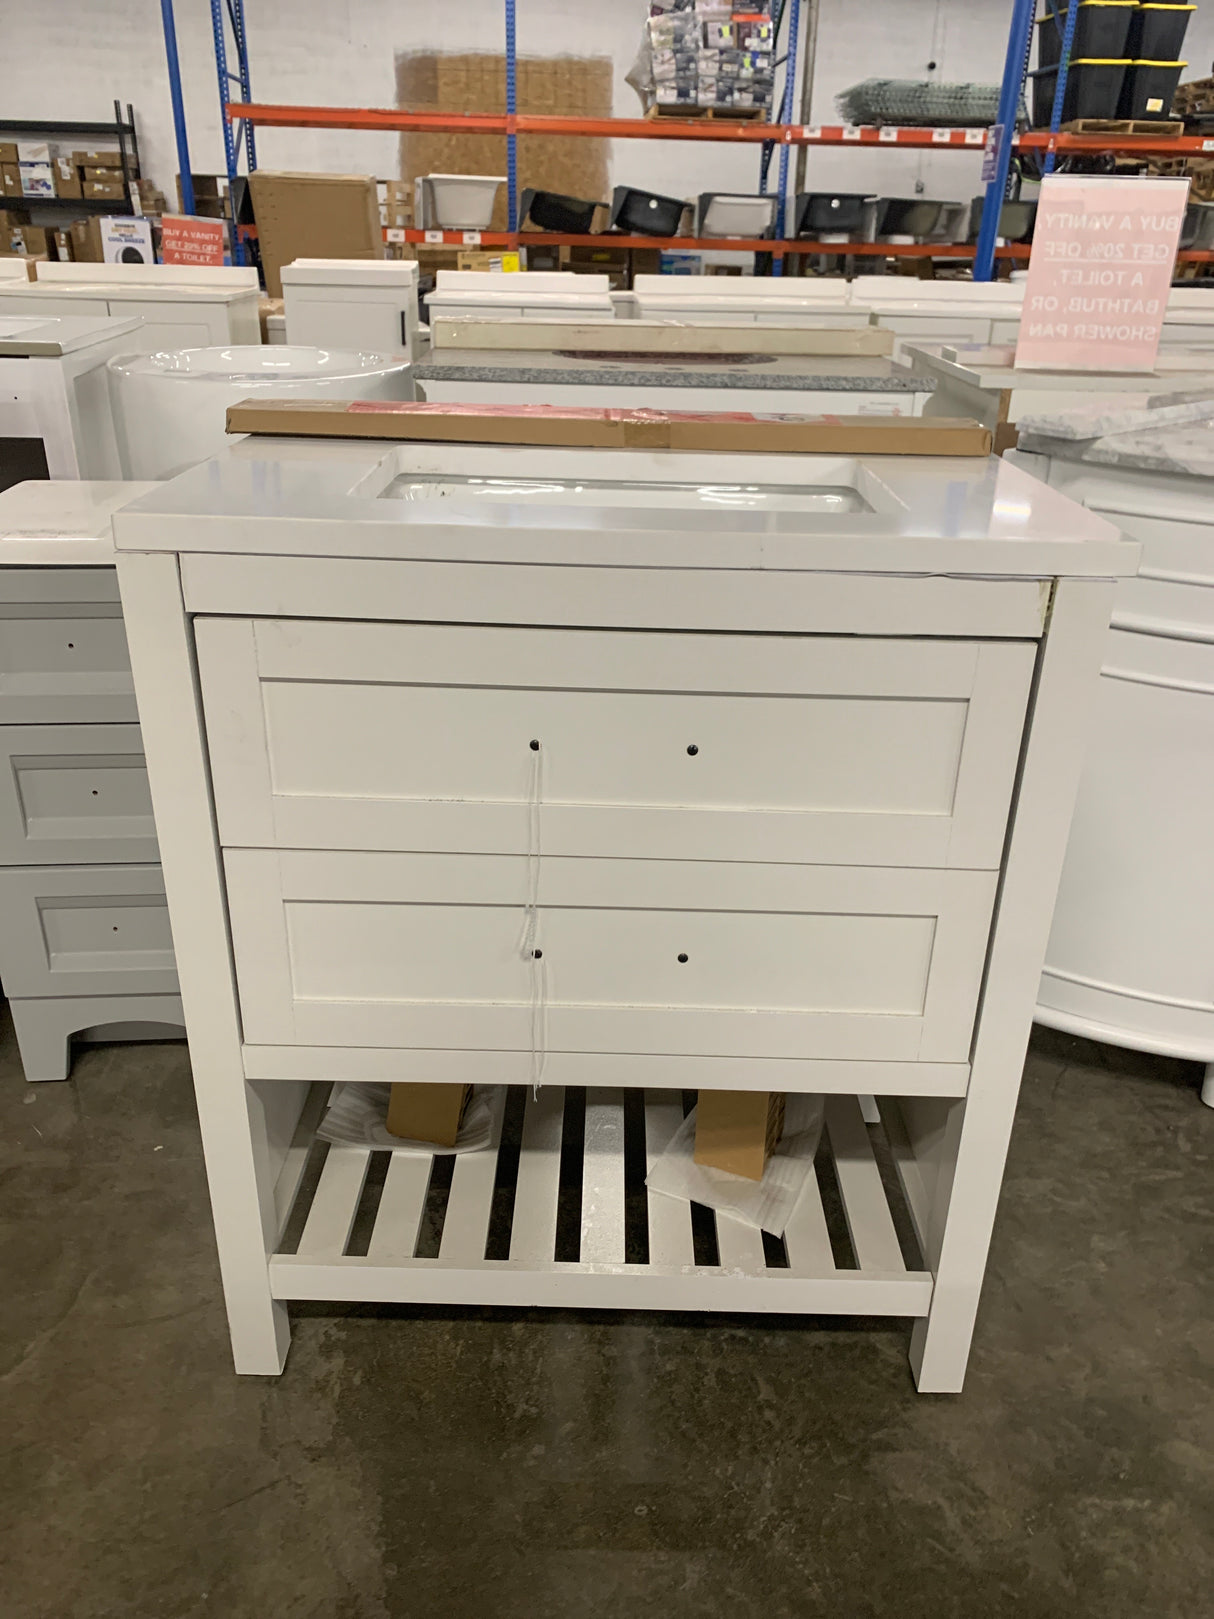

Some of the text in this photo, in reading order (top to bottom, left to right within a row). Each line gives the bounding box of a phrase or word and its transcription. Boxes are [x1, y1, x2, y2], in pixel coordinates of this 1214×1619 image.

[162, 228, 181, 237] BUY
[182, 230, 188, 238] A
[202, 244, 218, 253] OFF
